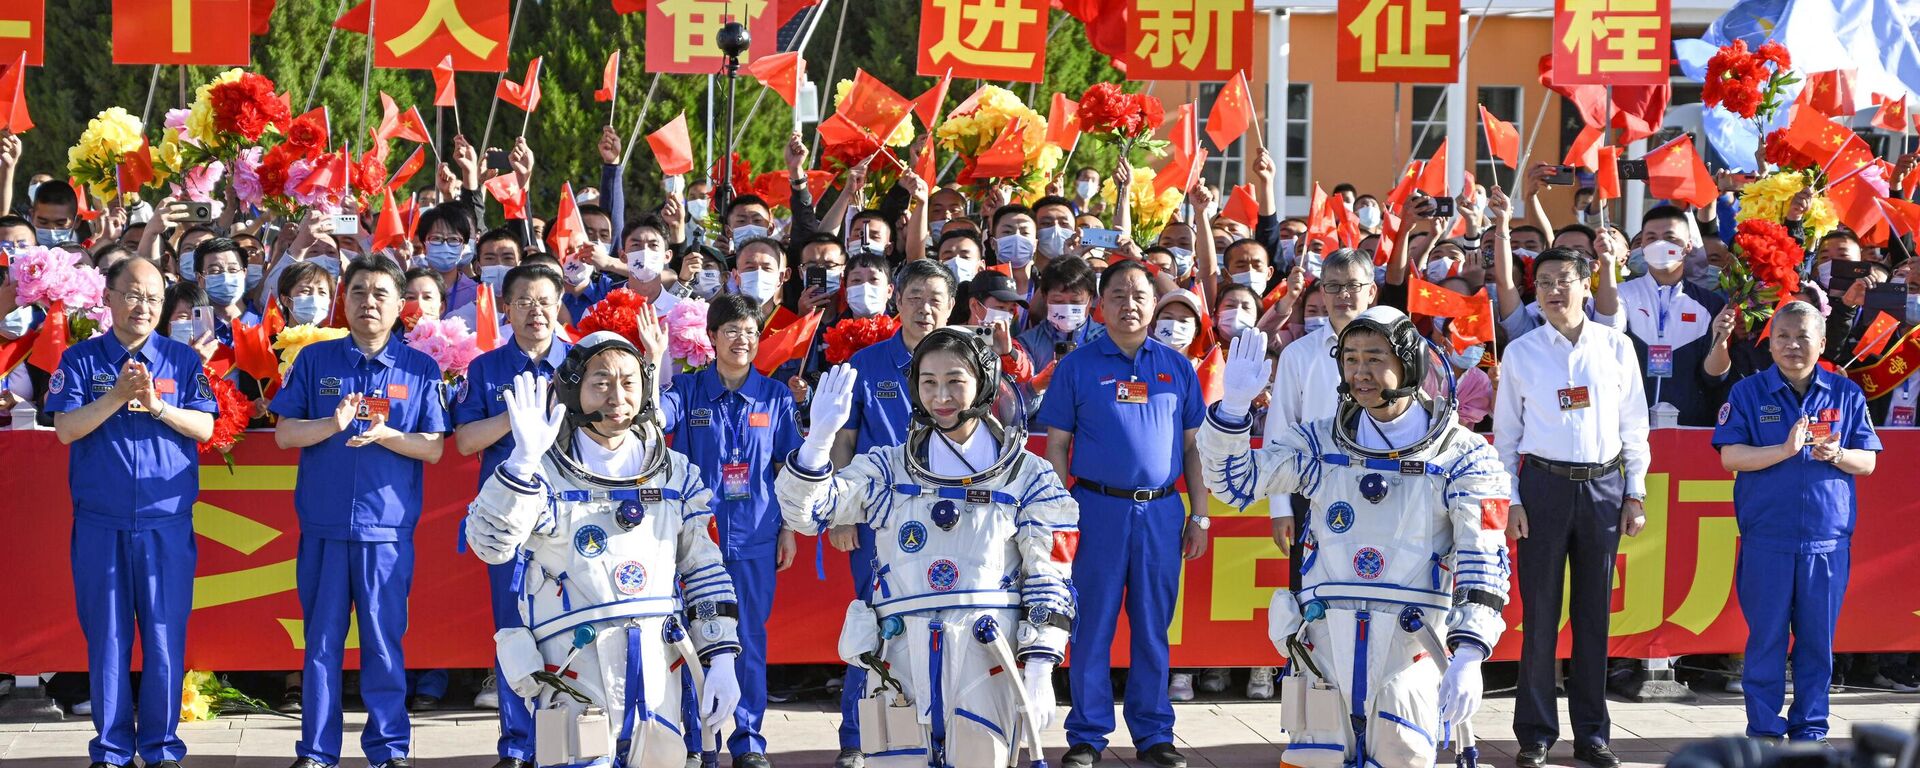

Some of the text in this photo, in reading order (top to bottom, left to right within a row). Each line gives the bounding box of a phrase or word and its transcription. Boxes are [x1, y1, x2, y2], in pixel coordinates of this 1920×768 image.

[928, 0, 1036, 69] 进
[1134, 0, 1245, 71] 新
[1347, 0, 1451, 73] 征
[1562, 0, 1664, 75] 程
